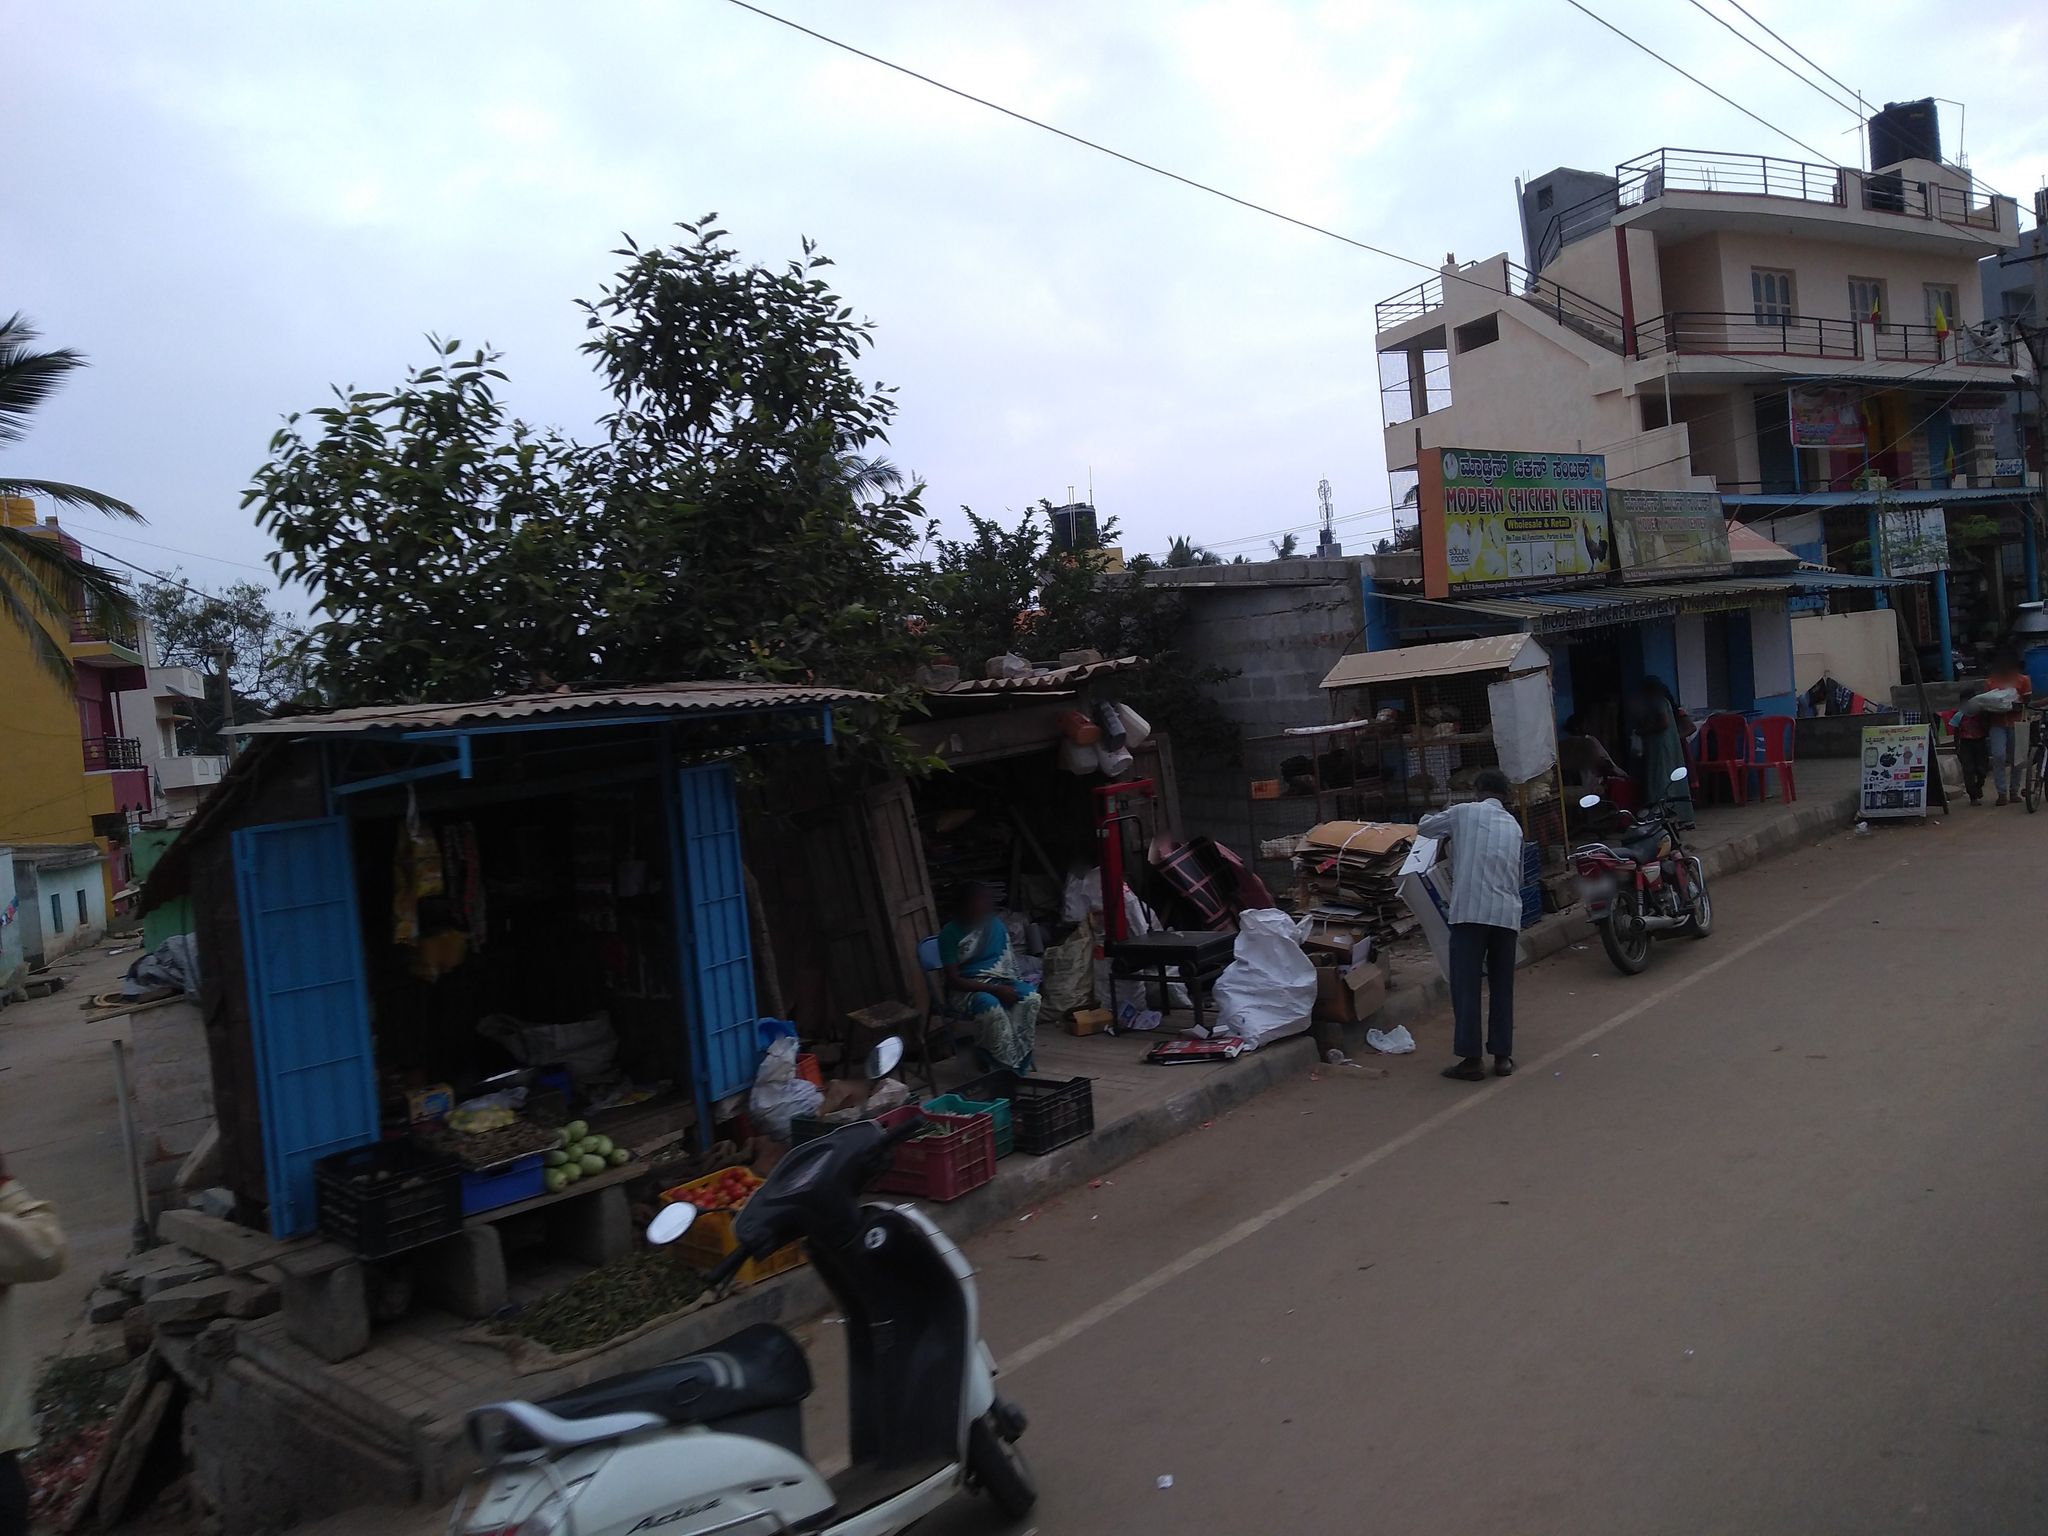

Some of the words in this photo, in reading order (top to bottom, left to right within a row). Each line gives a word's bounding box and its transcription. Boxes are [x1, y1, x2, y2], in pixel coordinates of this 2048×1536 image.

[1446, 488, 1504, 516] MODERN
[1508, 487, 1558, 516] CHICKEN
[1562, 487, 1604, 513] CENTER
[1507, 519, 1542, 529] Wholesale
[626, 1497, 722, 1536] Activa
